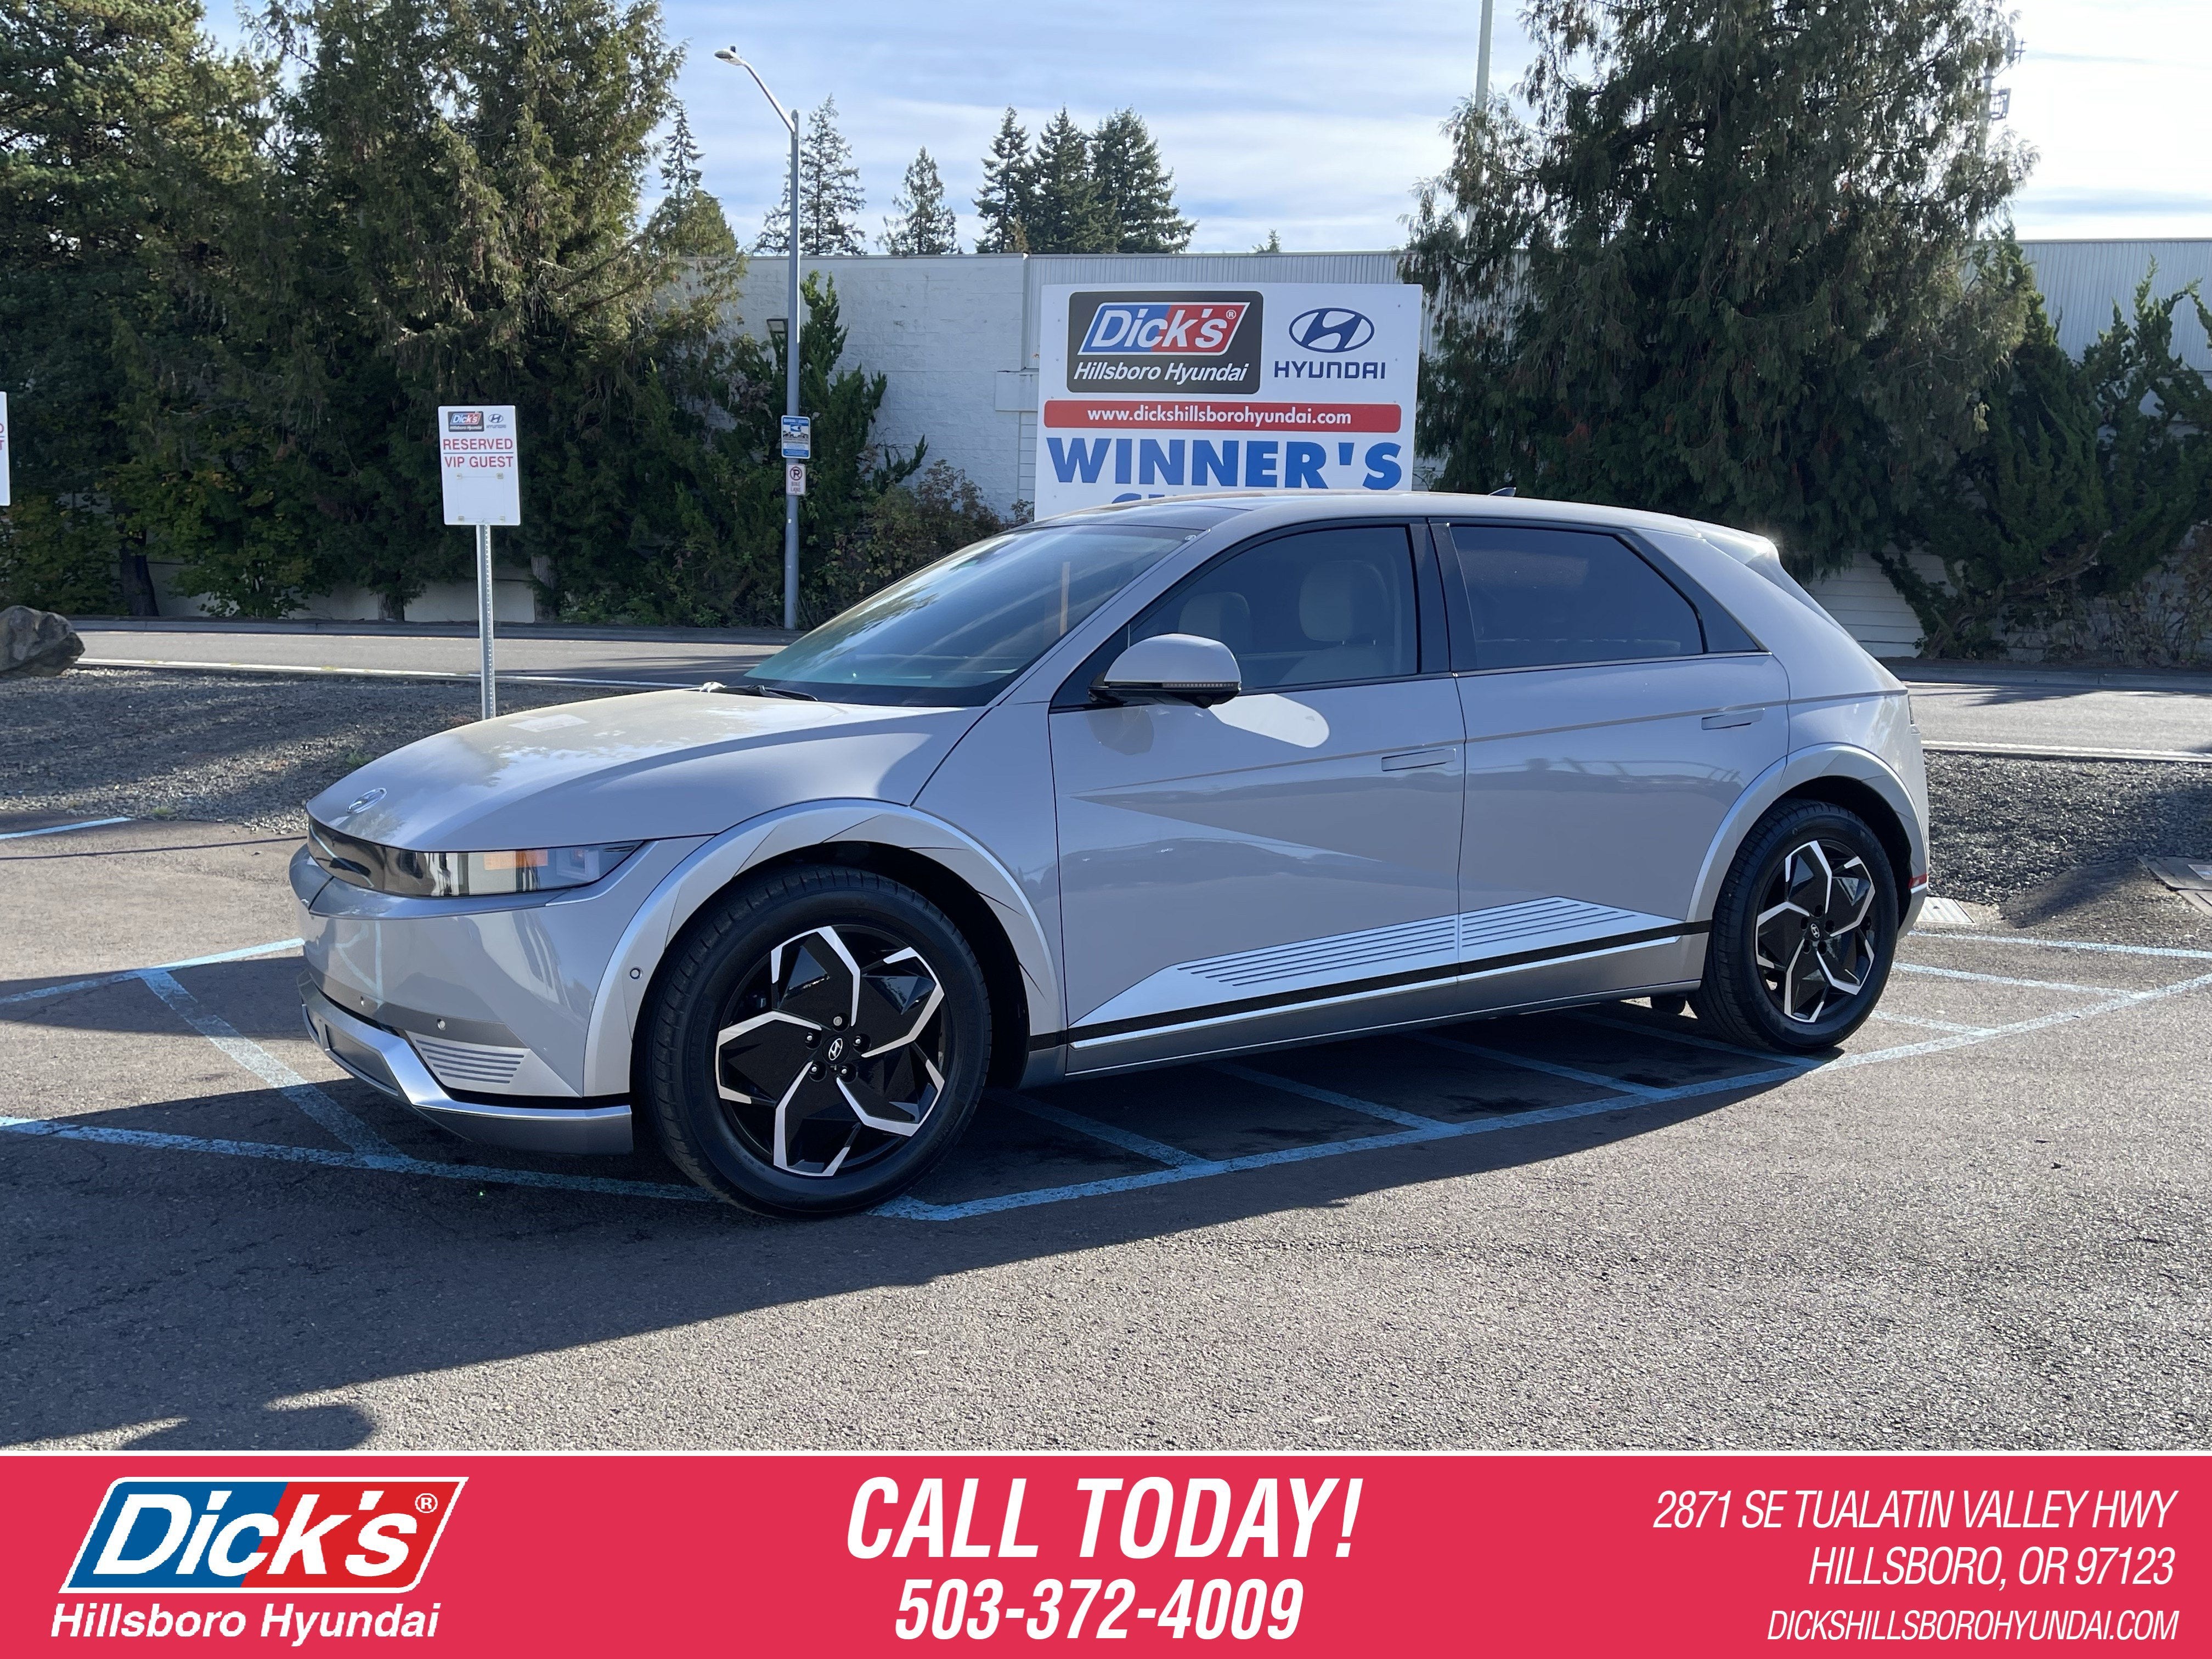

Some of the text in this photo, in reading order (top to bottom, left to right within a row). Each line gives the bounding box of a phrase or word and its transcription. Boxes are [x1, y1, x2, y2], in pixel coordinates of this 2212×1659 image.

[1091, 309, 1227, 348] Dick's
[1074, 362, 1249, 385] Hillsboro Hyundai
[1274, 360, 1386, 379] HYUNDAI
[453, 414, 478, 424] Dick's
[1087, 404, 1351, 427] www.dickshillsborohyundai.com
[443, 438, 513, 450] RESERVED
[444, 456, 514, 467] VIP GUEST
[1045, 436, 1402, 490] WINNER'S
